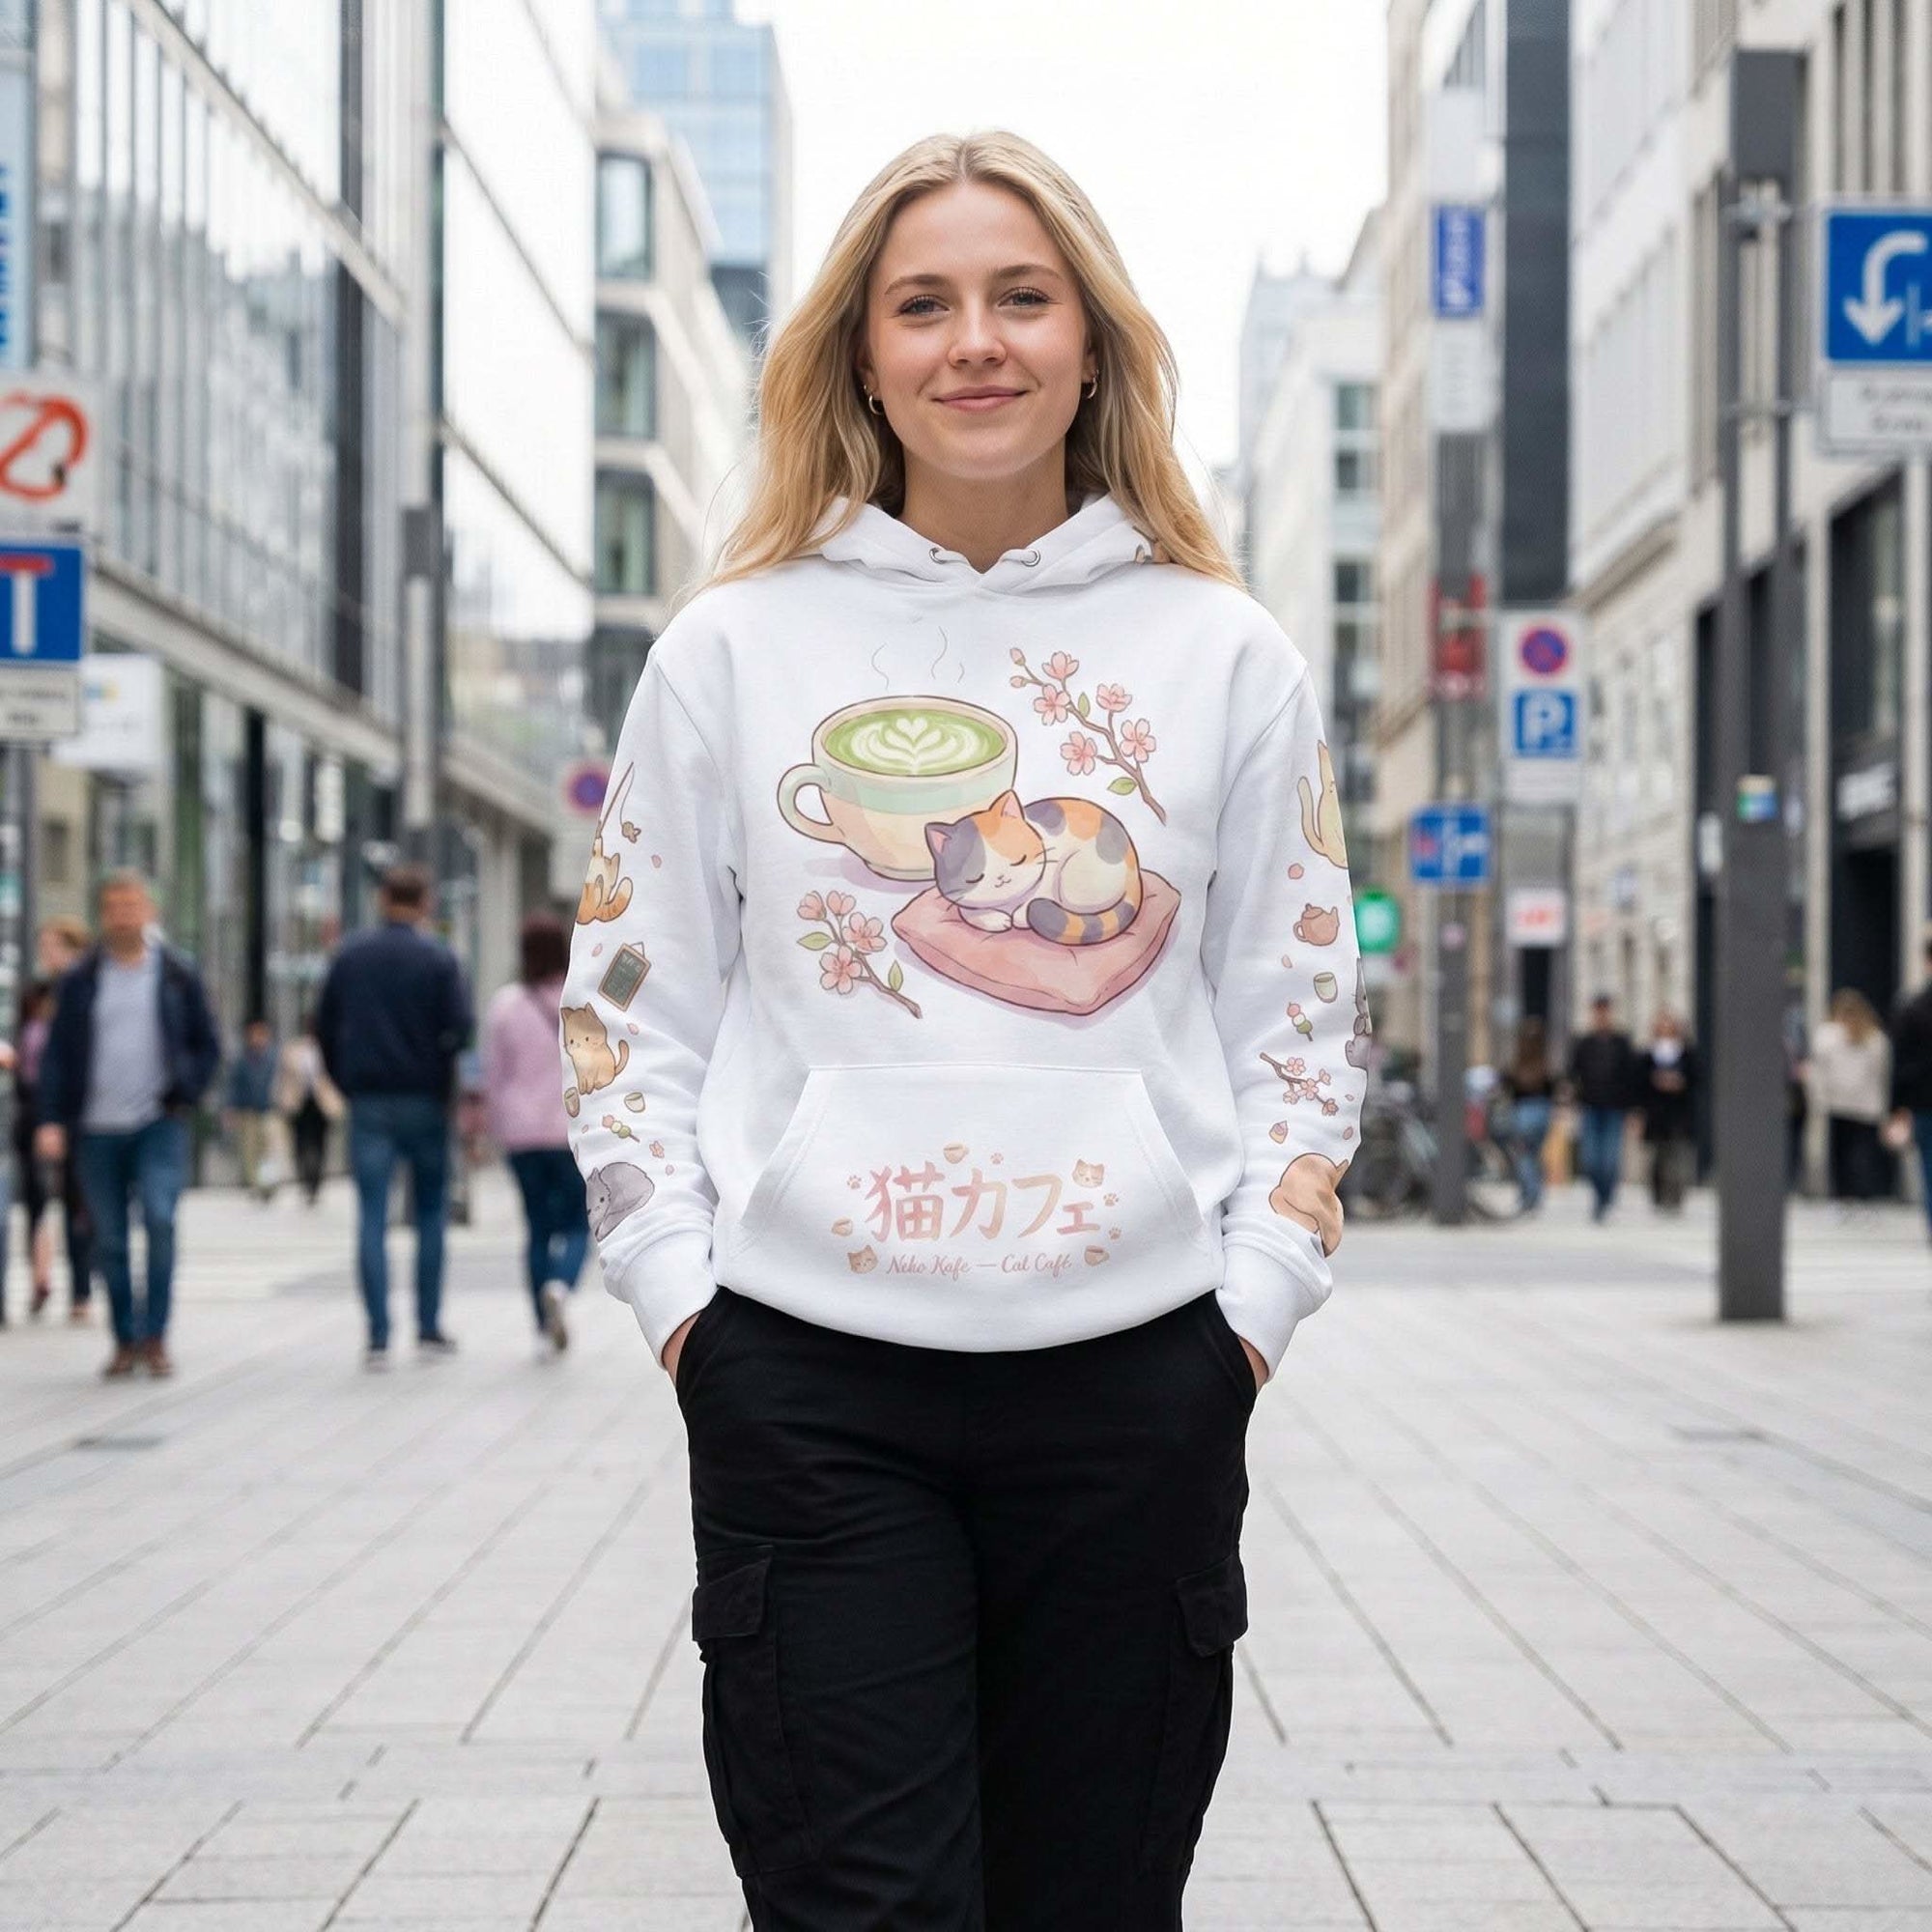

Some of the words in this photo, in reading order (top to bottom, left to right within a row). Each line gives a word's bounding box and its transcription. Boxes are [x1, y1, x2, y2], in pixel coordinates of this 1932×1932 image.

[1523, 693, 1566, 748] P
[865, 1162, 1101, 1242] 猫カフェ
[886, 1253, 925, 1274] Neko
[930, 1254, 971, 1282] Kafe
[1001, 1254, 1030, 1273] Cat
